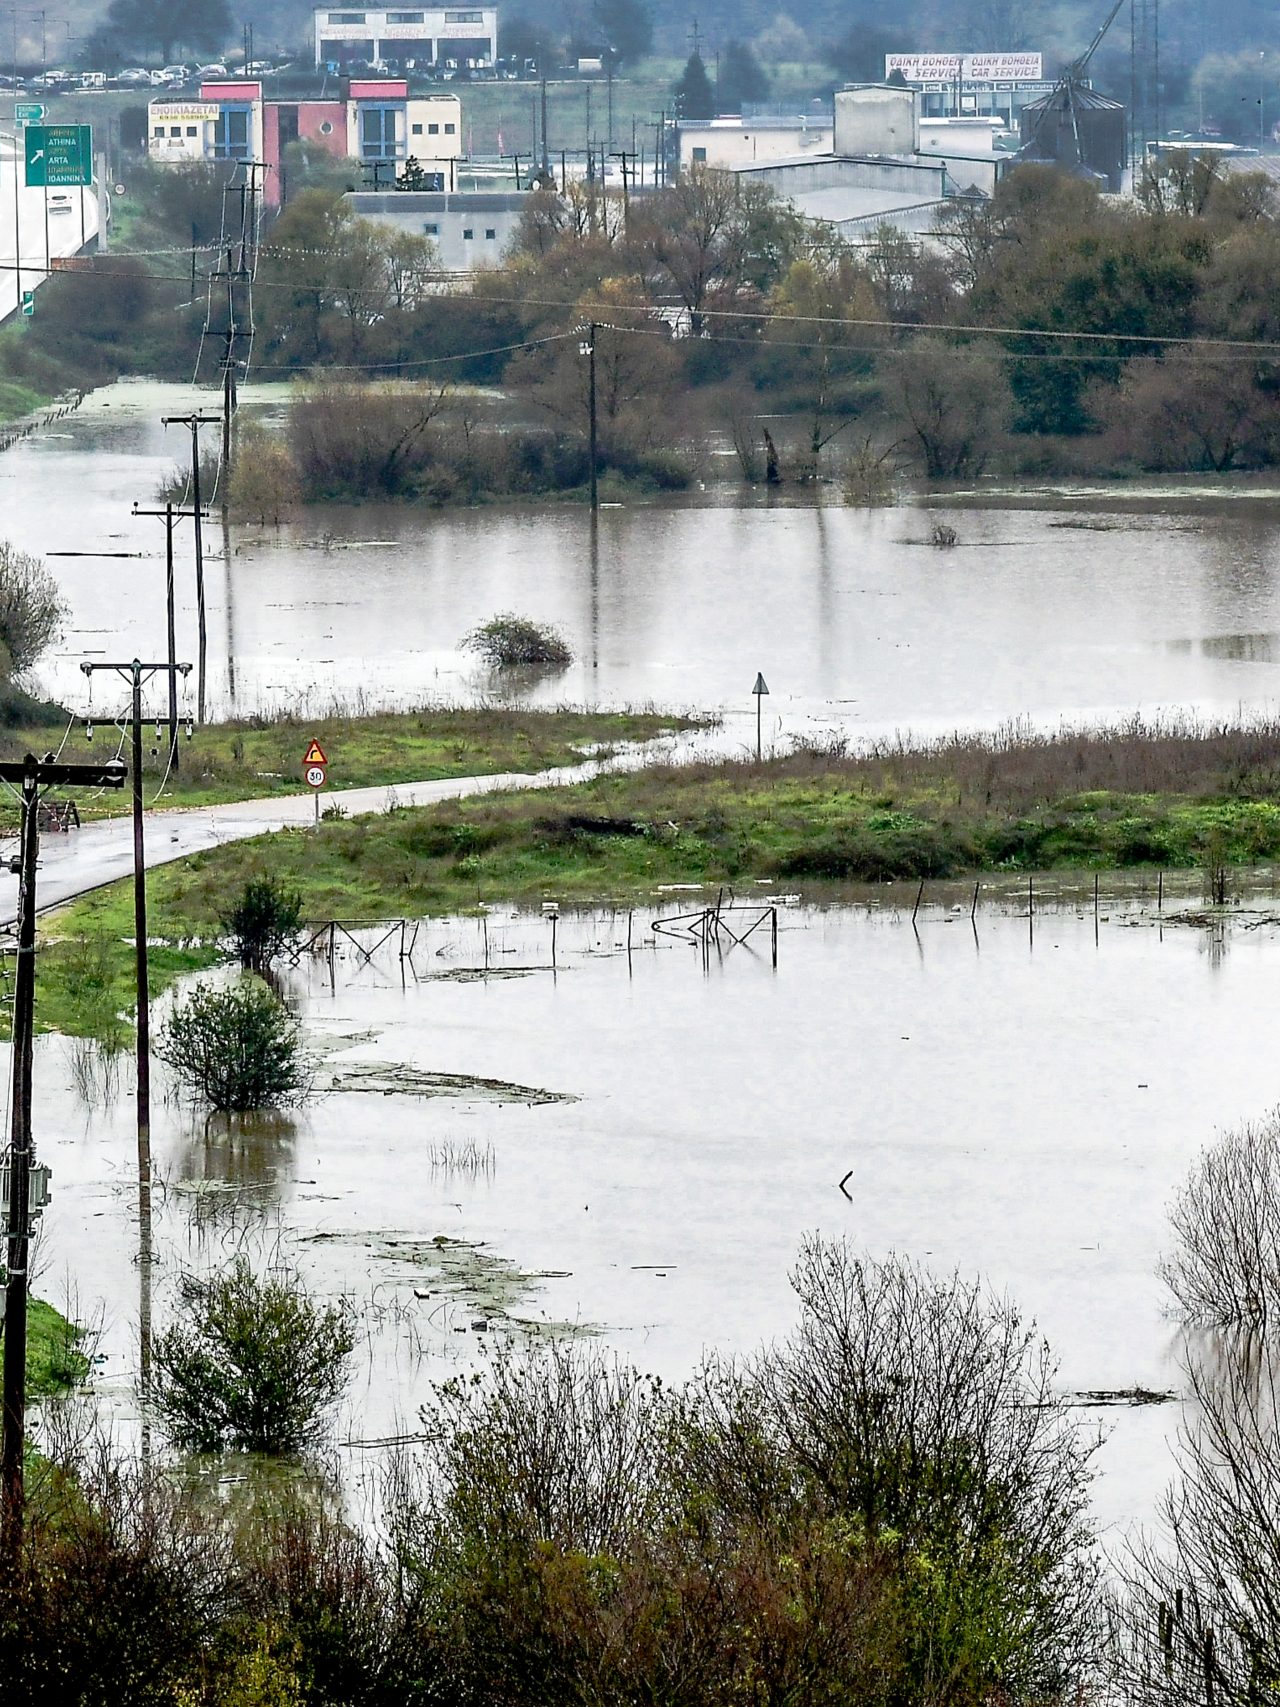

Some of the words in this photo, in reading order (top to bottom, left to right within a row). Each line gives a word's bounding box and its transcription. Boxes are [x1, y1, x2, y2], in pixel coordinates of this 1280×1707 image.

[890, 57, 920, 66] ΟΔΙΚΗ
[971, 57, 998, 66] ΟΔΙΚΗ
[1001, 56, 1039, 65] ΒΟΗΘΕΙΑ
[971, 69, 989, 77] CAR
[993, 67, 1038, 77] SERVICE
[48, 138, 77, 146] ATHINA
[48, 156, 69, 164] ARTA
[309, 772, 322, 781] 30
